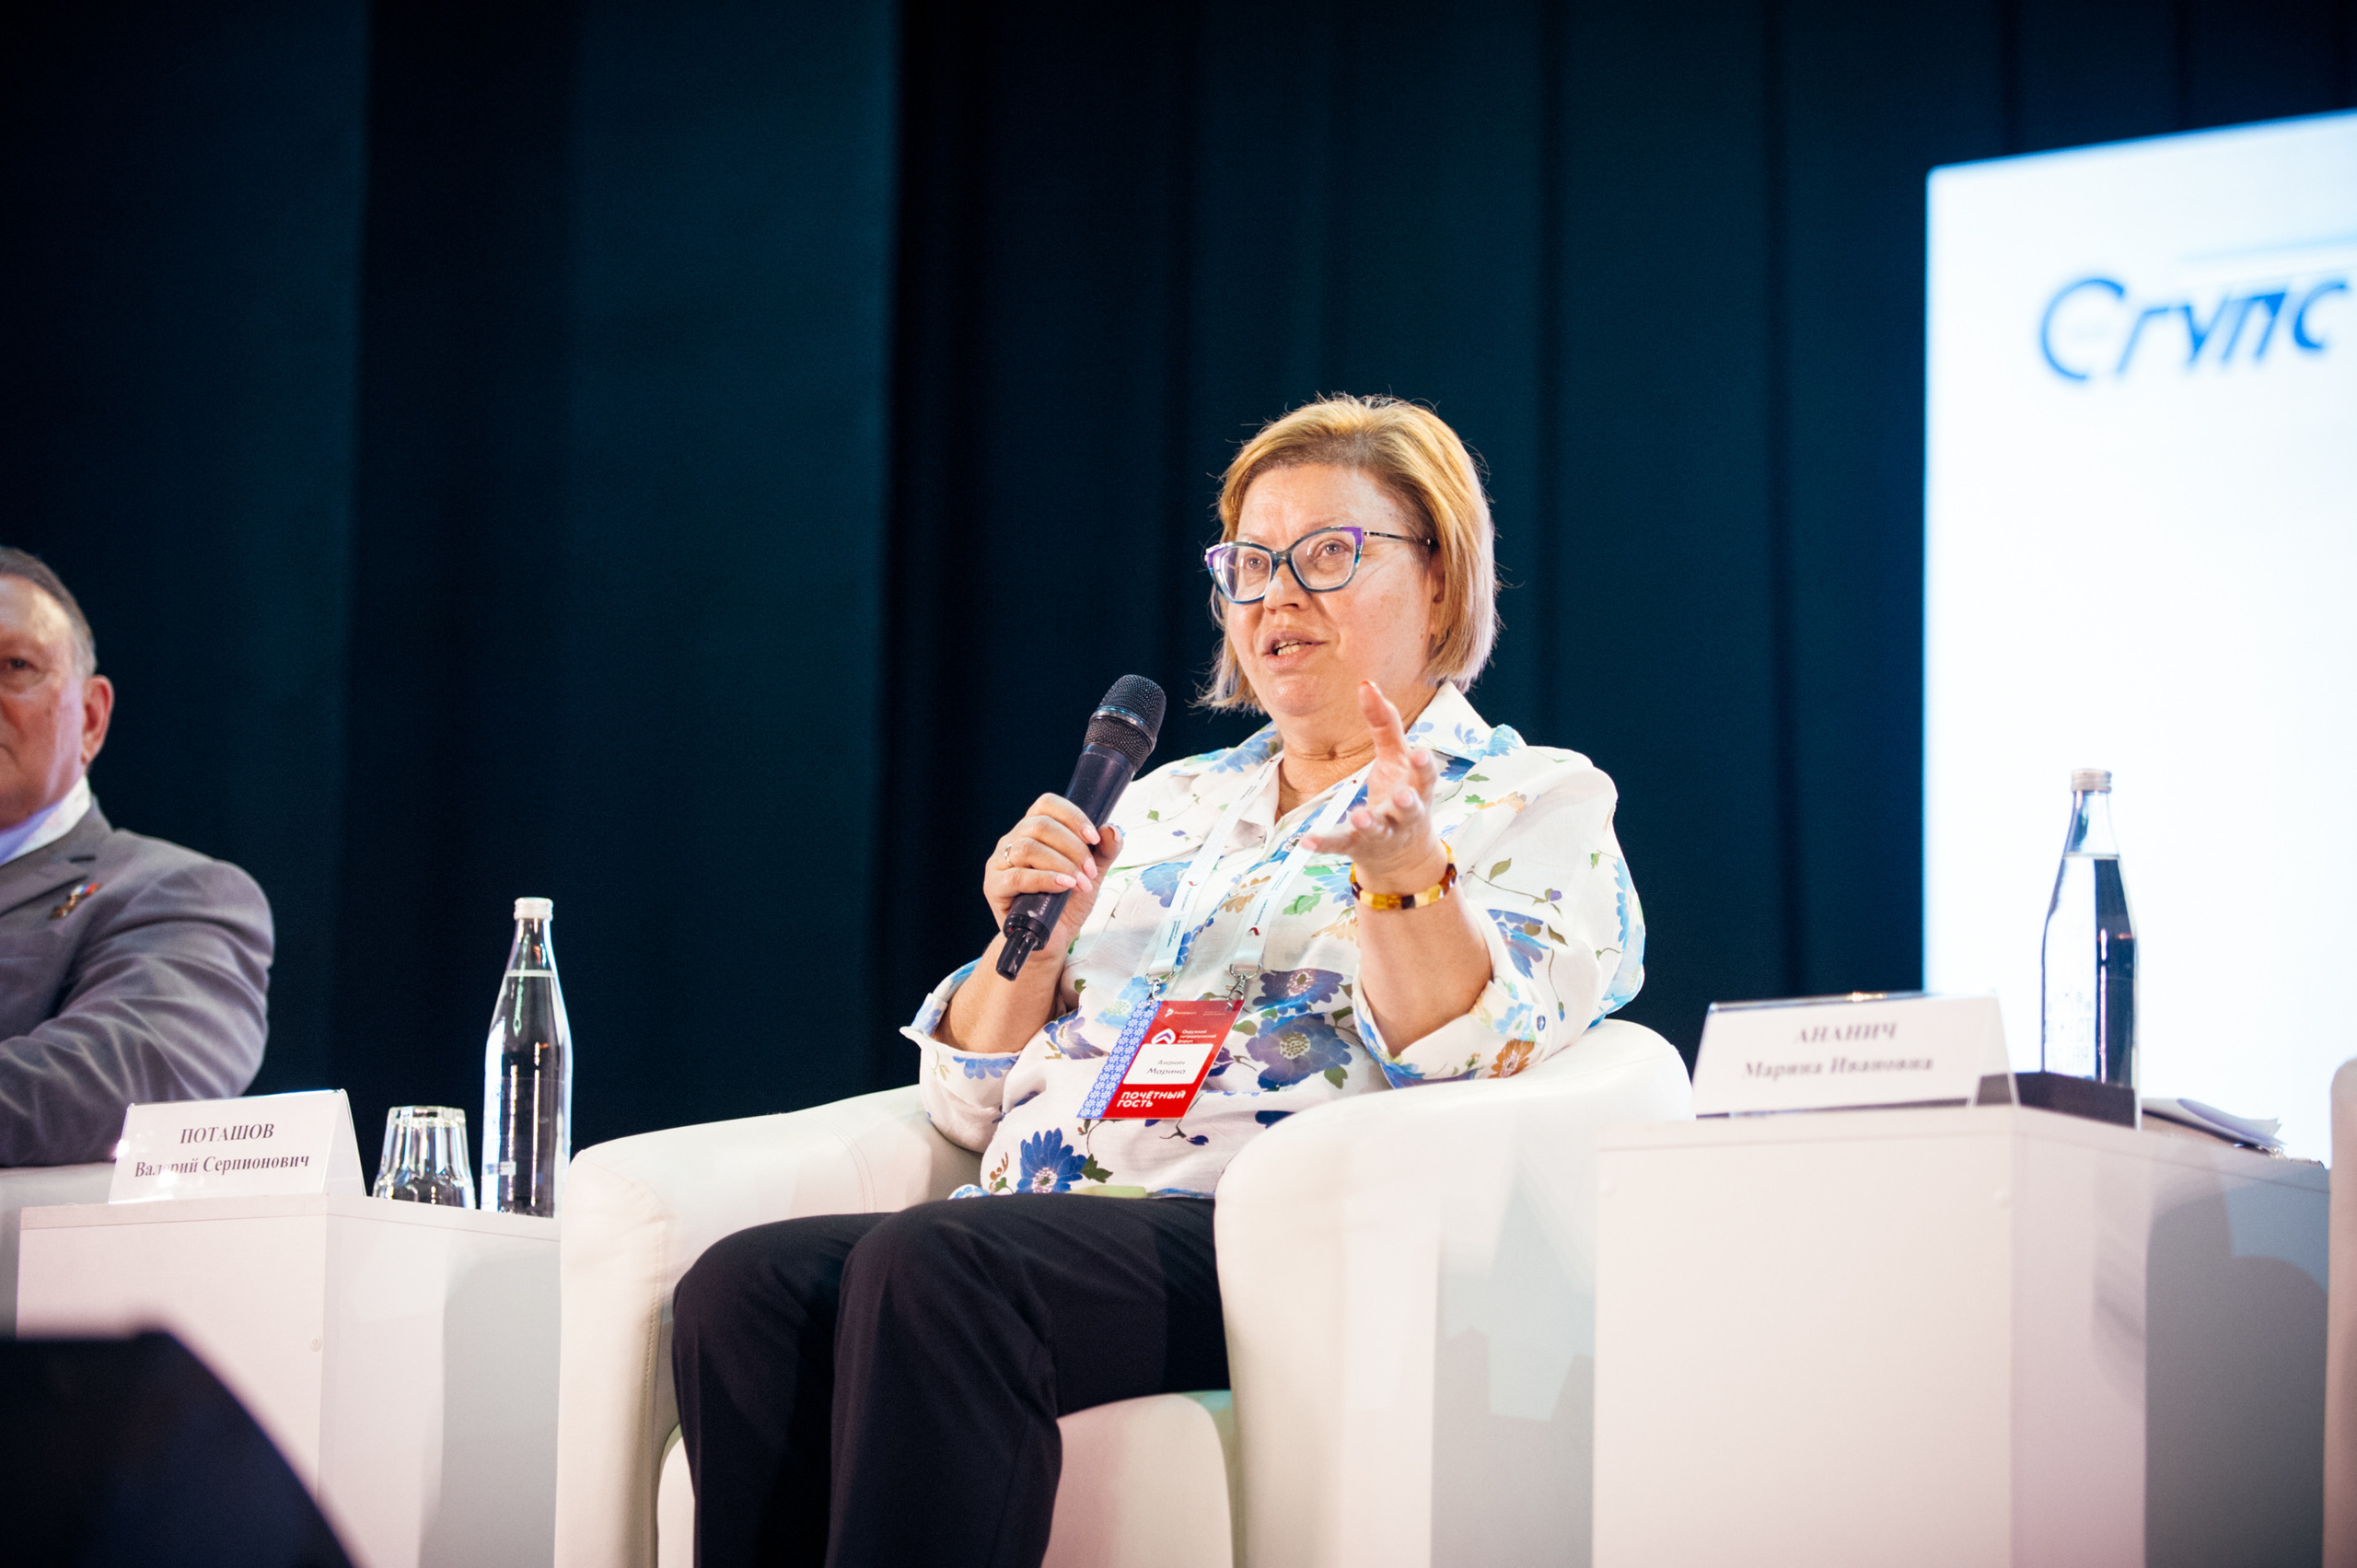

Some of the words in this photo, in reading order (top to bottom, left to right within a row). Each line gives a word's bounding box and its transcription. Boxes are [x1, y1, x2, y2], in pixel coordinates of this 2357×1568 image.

[1795, 1023, 1898, 1043] АНАНИЧ
[1743, 1062, 1823, 1081] Марина
[1829, 1057, 1933, 1074] Ивановна
[1117, 1099, 1154, 1108] ГОСТЬ
[1120, 1090, 1187, 1099] ПОЧЁТНЫЙ
[180, 1123, 274, 1144] ПОТАШОВ
[203, 1155, 310, 1176] Серпионович
